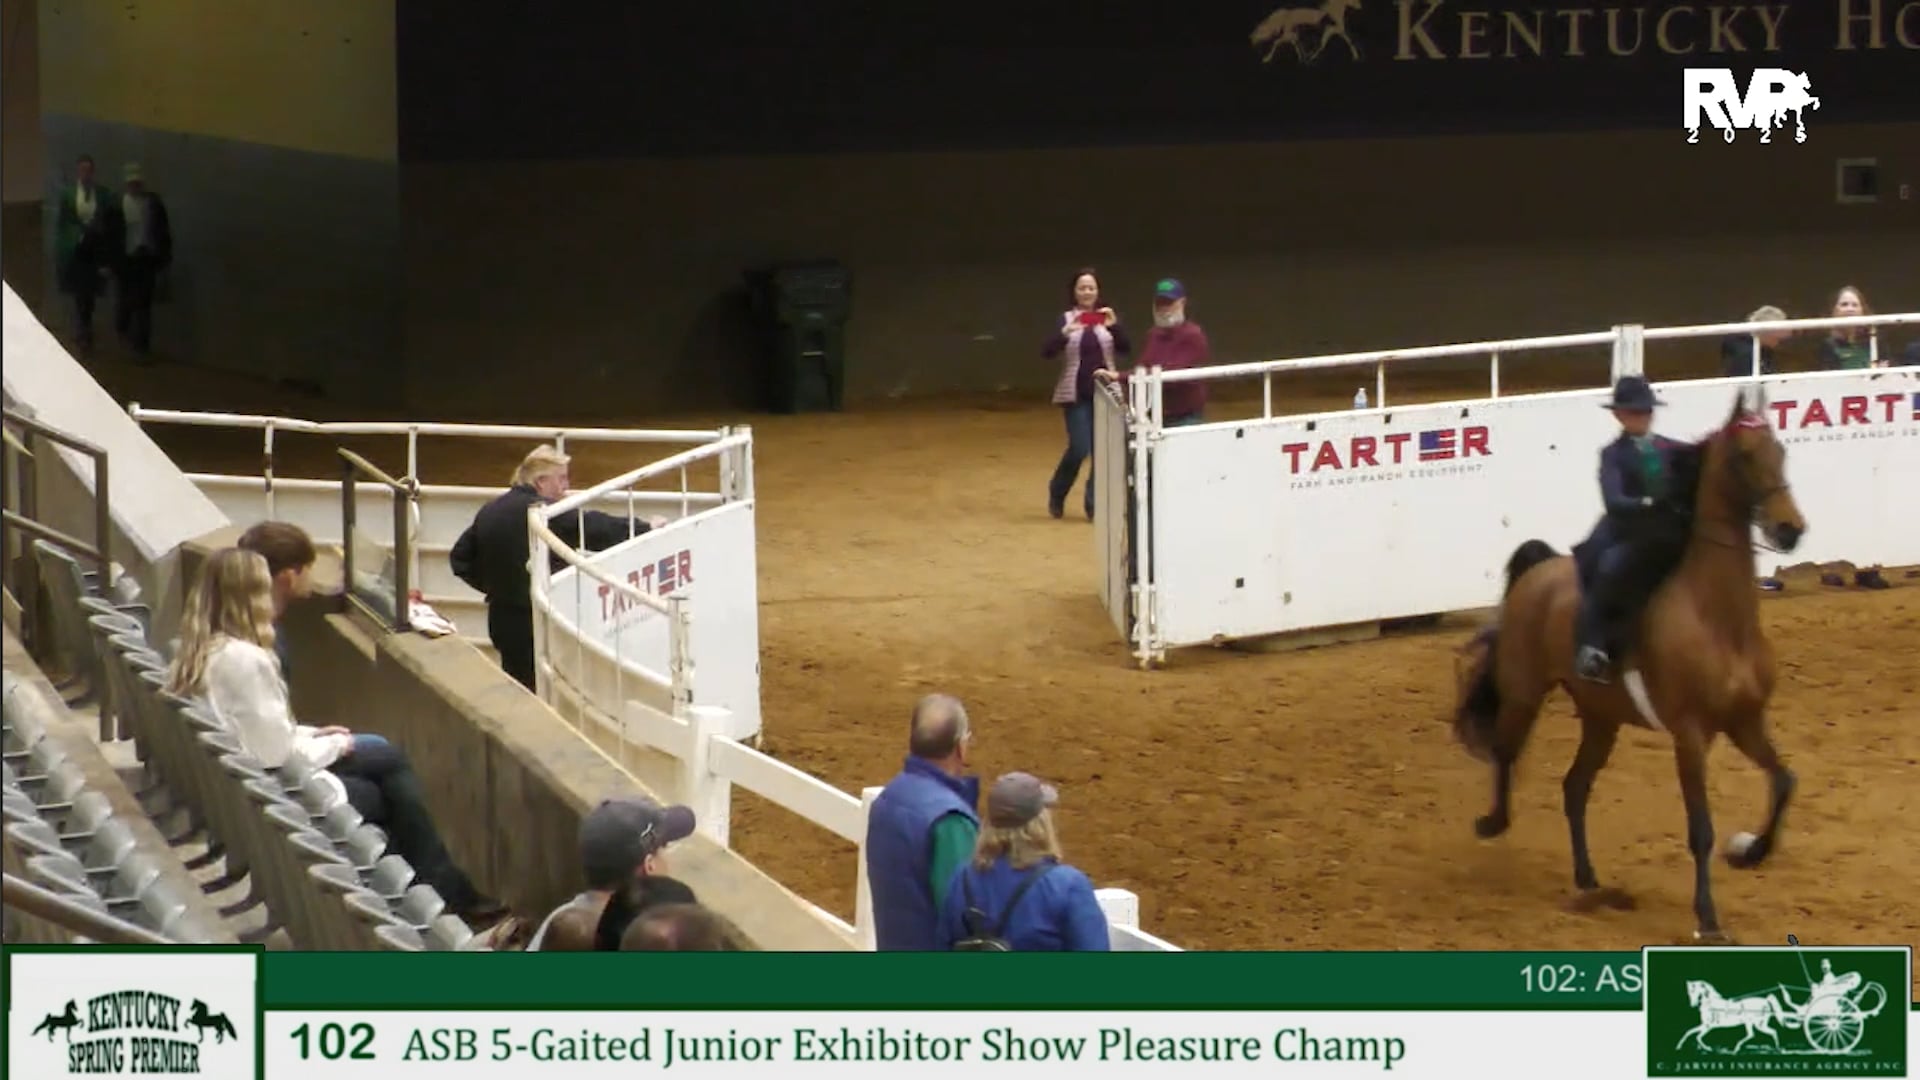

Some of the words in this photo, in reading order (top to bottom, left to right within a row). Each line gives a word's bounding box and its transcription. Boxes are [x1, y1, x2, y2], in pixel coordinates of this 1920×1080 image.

[1393, 0, 1788, 59] KENTUCKY
[1770, 393, 1920, 430] TART
[1281, 425, 1492, 474] TARTER
[1290, 480, 1322, 491] FARM
[1328, 476, 1354, 487] AND
